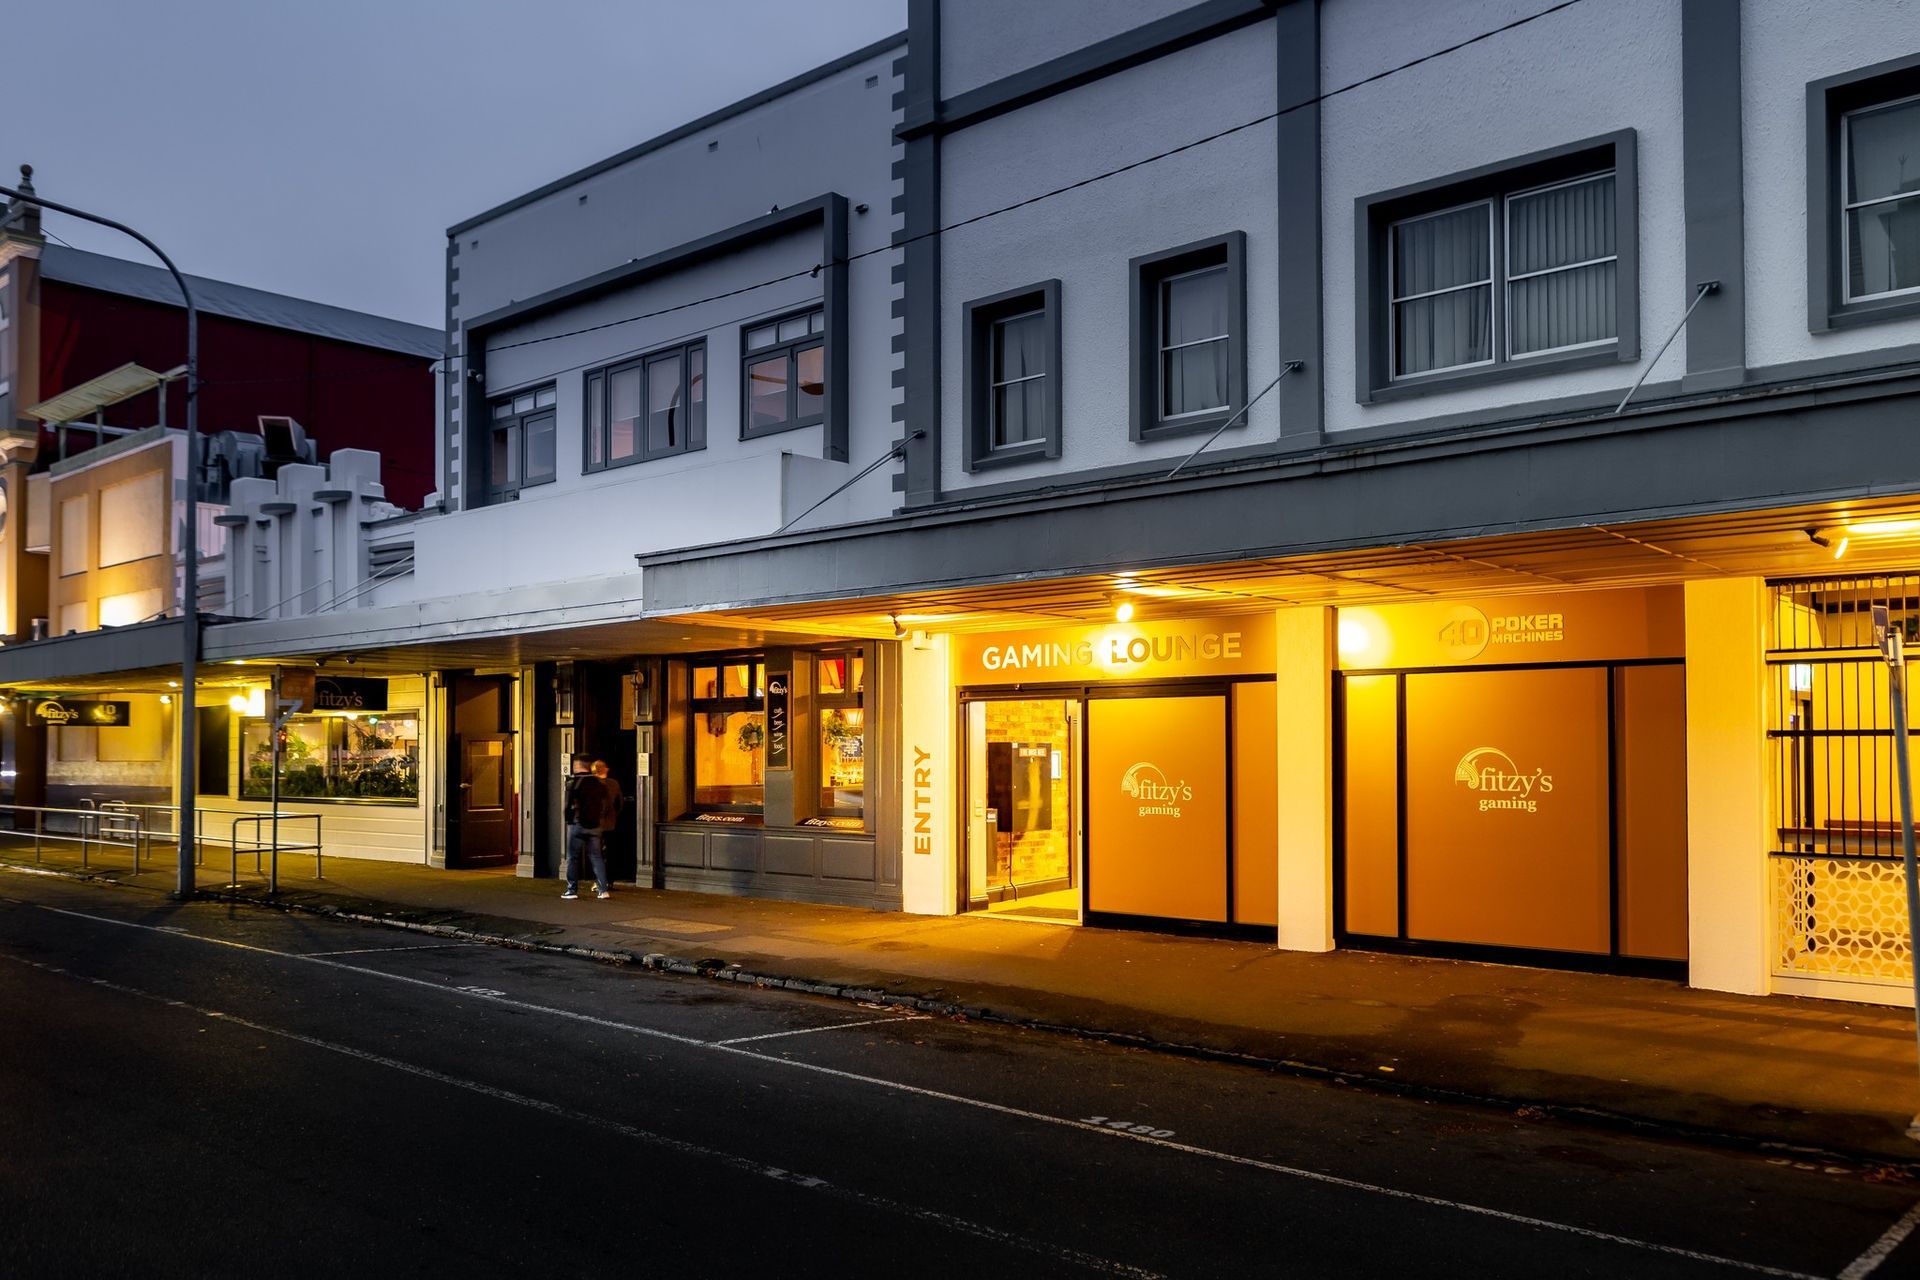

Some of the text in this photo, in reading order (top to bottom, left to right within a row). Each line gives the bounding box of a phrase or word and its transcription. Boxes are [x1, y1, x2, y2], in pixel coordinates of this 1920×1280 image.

[1439, 619, 1484, 646] 40
[1491, 614, 1564, 631] POKER
[1491, 630, 1564, 644] MACHINES
[982, 632, 1242, 670] GAMING LOUNGE
[1139, 779, 1192, 805] fitzy's
[1479, 767, 1553, 798] fitzy's
[914, 745, 931, 855] ENTRY
[1139, 804, 1181, 818] gaming
[1479, 796, 1537, 813] gaming
[1080, 1116, 1176, 1137] 1480
